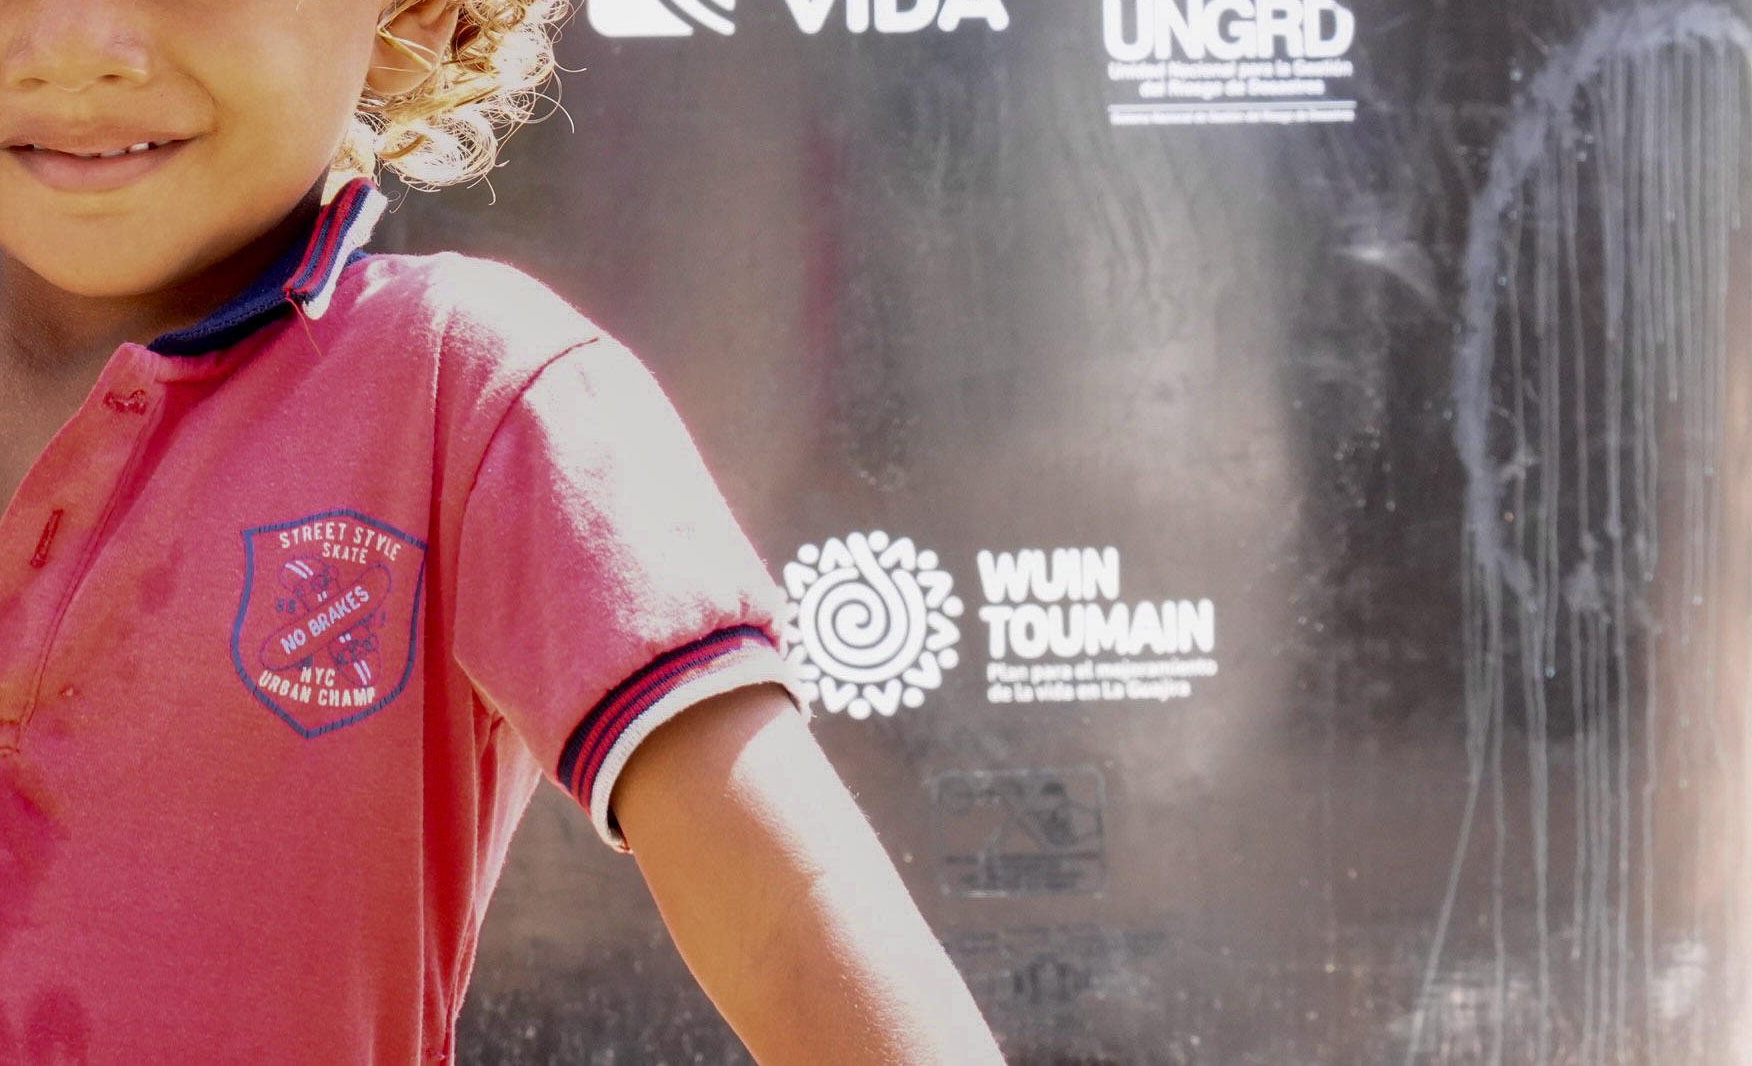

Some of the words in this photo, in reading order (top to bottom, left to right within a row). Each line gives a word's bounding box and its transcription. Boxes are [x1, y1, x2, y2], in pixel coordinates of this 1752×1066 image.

[279, 521, 347, 549] STREET
[353, 526, 402, 561] STYLE
[322, 542, 368, 564] SKATE
[977, 546, 1120, 603] WUIN
[280, 629, 307, 654] NO
[308, 586, 370, 637] BRAKES
[978, 598, 1214, 659] TOUMAIN
[258, 670, 312, 704] URBAN
[317, 687, 376, 707] CHAMP
[299, 666, 336, 686] NYC
